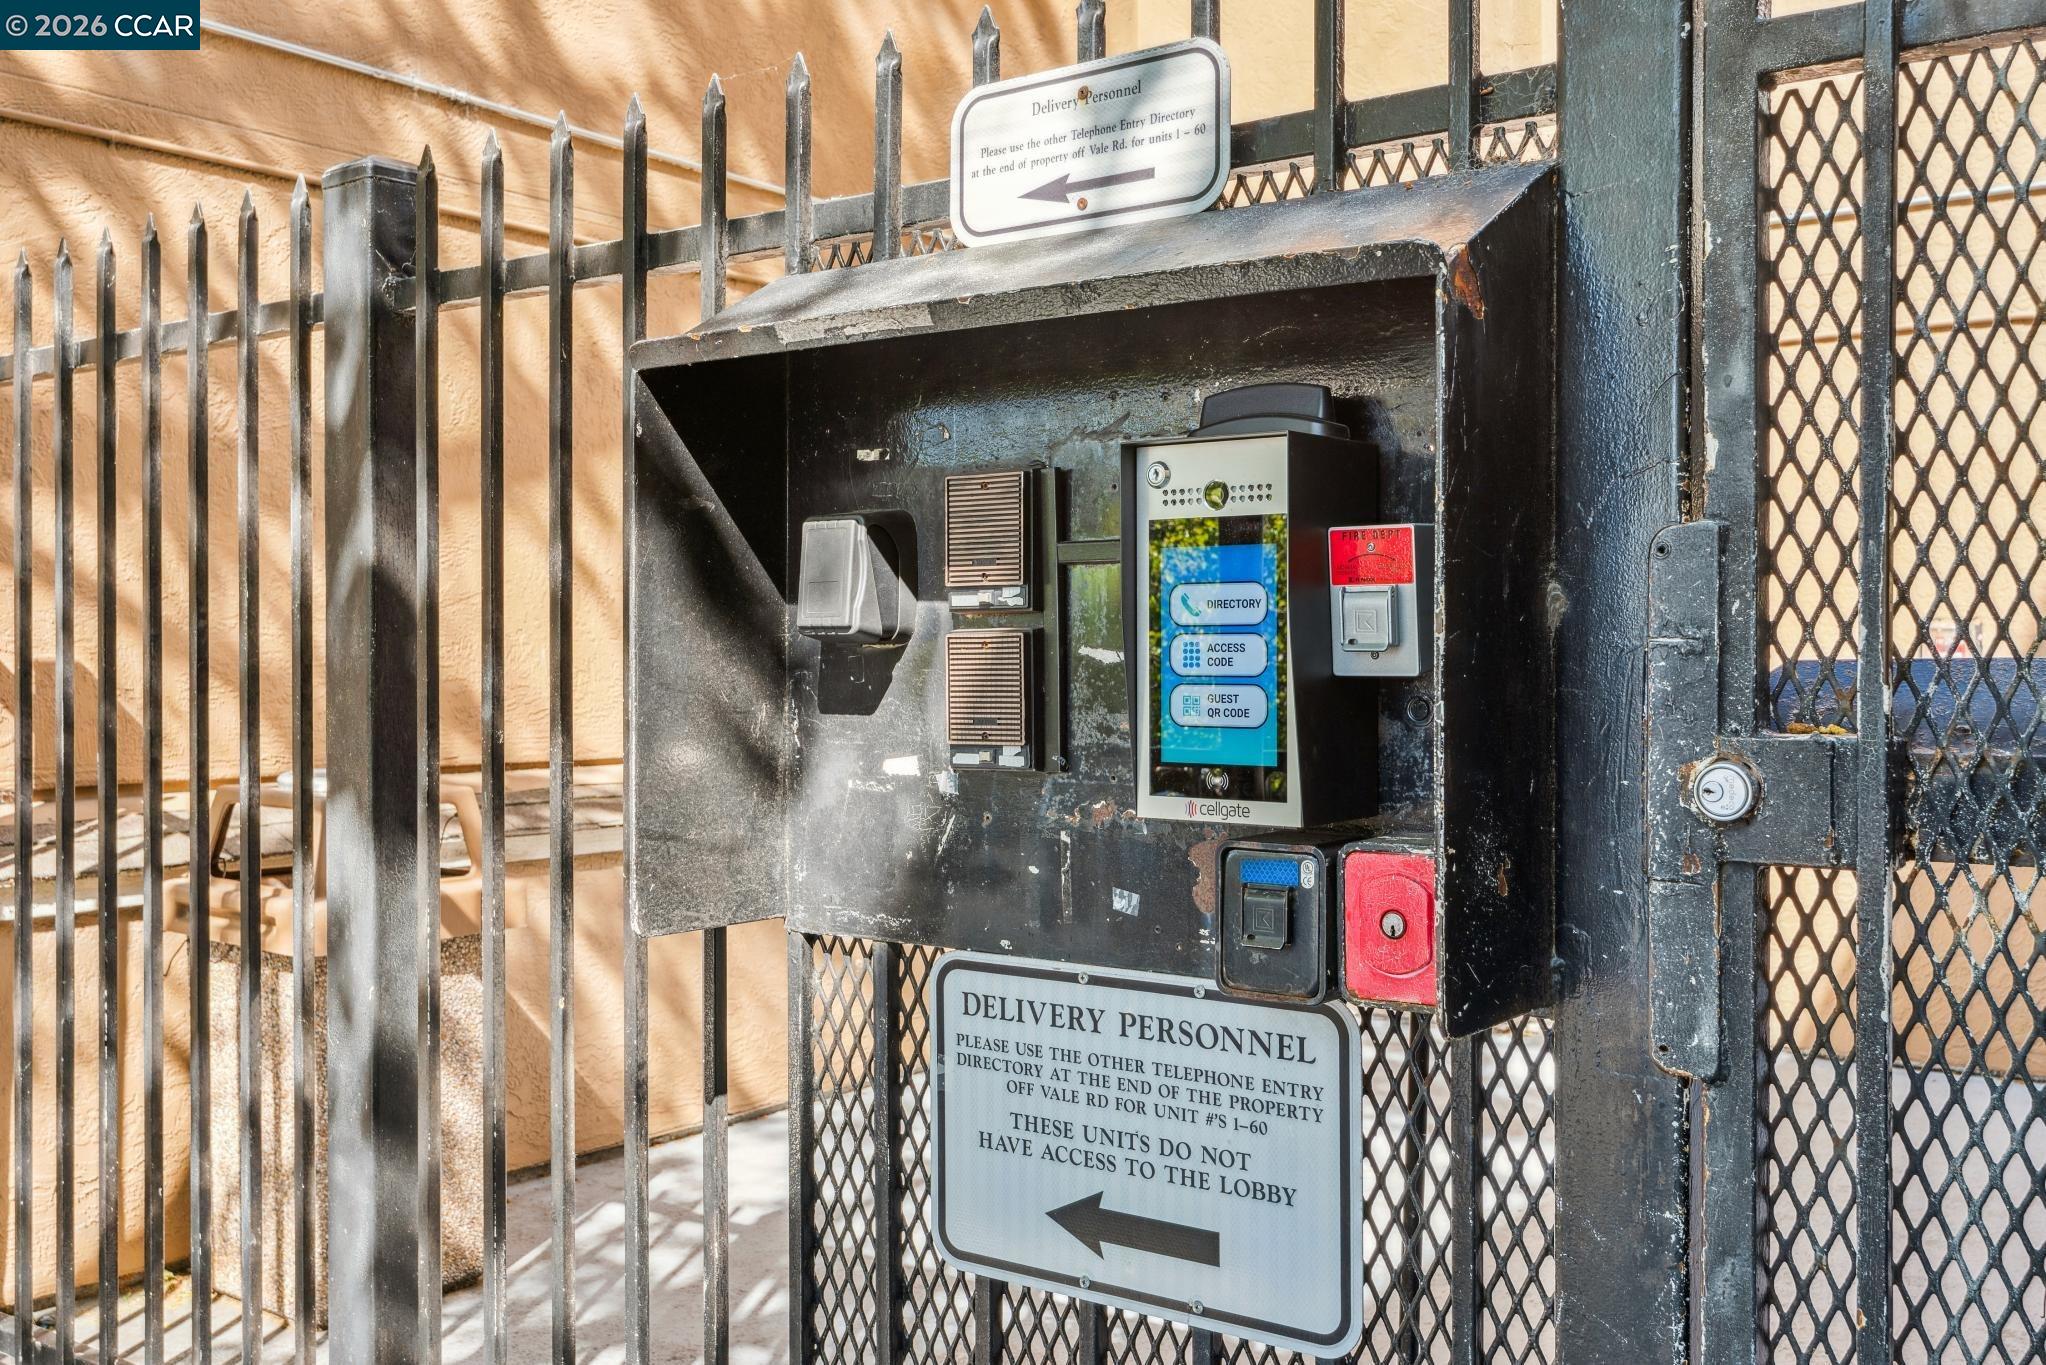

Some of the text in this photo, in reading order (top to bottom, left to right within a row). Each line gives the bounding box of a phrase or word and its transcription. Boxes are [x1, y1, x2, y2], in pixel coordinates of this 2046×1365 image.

[1032, 80, 1142, 116] Delivery Personnel
[971, 169, 980, 179] at
[982, 165, 997, 176] the
[999, 159, 1016, 172] end
[1018, 157, 1028, 169] of
[1030, 153, 1069, 169] property
[1072, 147, 1086, 159] off
[1090, 143, 1110, 156] Vale
[1112, 138, 1129, 151] Rd.
[1131, 134, 1146, 146] for
[1149, 131, 1174, 145] units
[1194, 122, 1207, 136] 60
[980, 108, 1196, 158] Please use the other Telephone Entry Directory
[1342, 529, 1401, 540] FIRE DEPT
[1206, 598, 1262, 610] DIRECTORY
[1206, 643, 1246, 653] ACCESS
[1207, 657, 1234, 667] CODE
[1207, 694, 1239, 704] GUEST
[1207, 708, 1250, 718] QR CODE
[1199, 803, 1251, 820] cellgate
[961, 991, 1317, 1065] DELIVERY PERSONNEL
[956, 1033, 1325, 1102] PLEASE USE THE OTHER TELEPHONE ENTRY
[957, 1052, 1324, 1124] DIRECTORY AT THE END OF THE PROPERTY
[1006, 1079, 1035, 1096] OFF
[1040, 1084, 1080, 1104] VALE
[1086, 1092, 1109, 1109] RD
[1115, 1096, 1147, 1115] FOR
[1154, 1103, 1199, 1124] UNIT
[1010, 1112, 1252, 1172] THESE UNITS DO NOT
[978, 1130, 1297, 1207] HAVE ACCESS TO THE LOBBY
